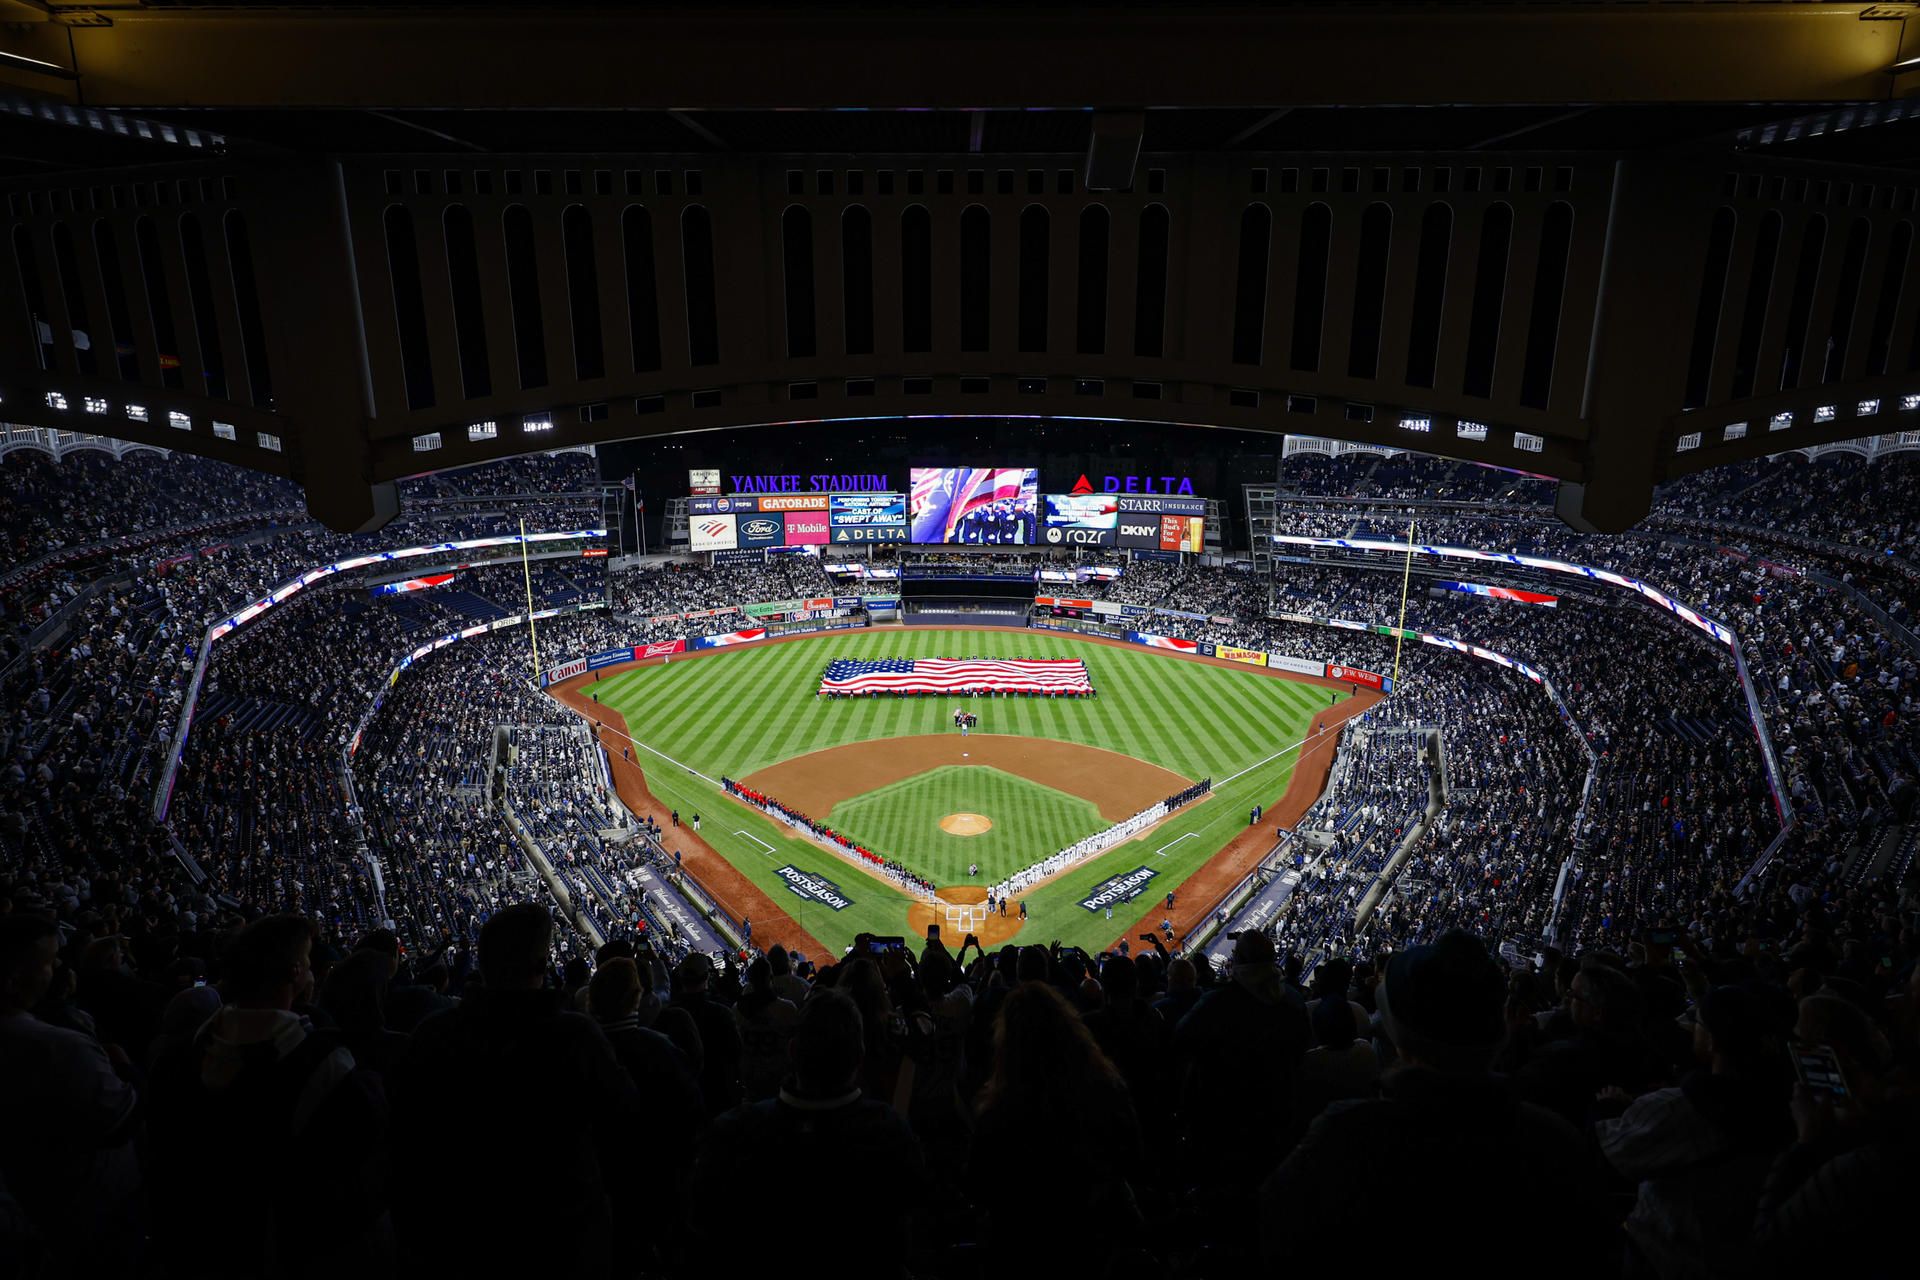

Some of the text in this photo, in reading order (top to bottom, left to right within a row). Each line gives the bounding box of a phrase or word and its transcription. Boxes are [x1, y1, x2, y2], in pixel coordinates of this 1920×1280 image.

[731, 474, 888, 493] YANKEE STADIUM
[1103, 475, 1194, 495] DELTA
[763, 497, 826, 509] GATORADE
[1119, 498, 1205, 512] STARR INSURANCE
[747, 521, 774, 534] Ford
[797, 524, 828, 534] Mobile
[854, 528, 906, 540] DELTA
[1120, 525, 1157, 537] DKNY
[1066, 530, 1107, 544] razr
[497, 618, 516, 628] ORIS
[549, 661, 587, 682] Canon
[778, 866, 849, 909] POSTSEASON
[1082, 868, 1155, 910] POSTSEASON
